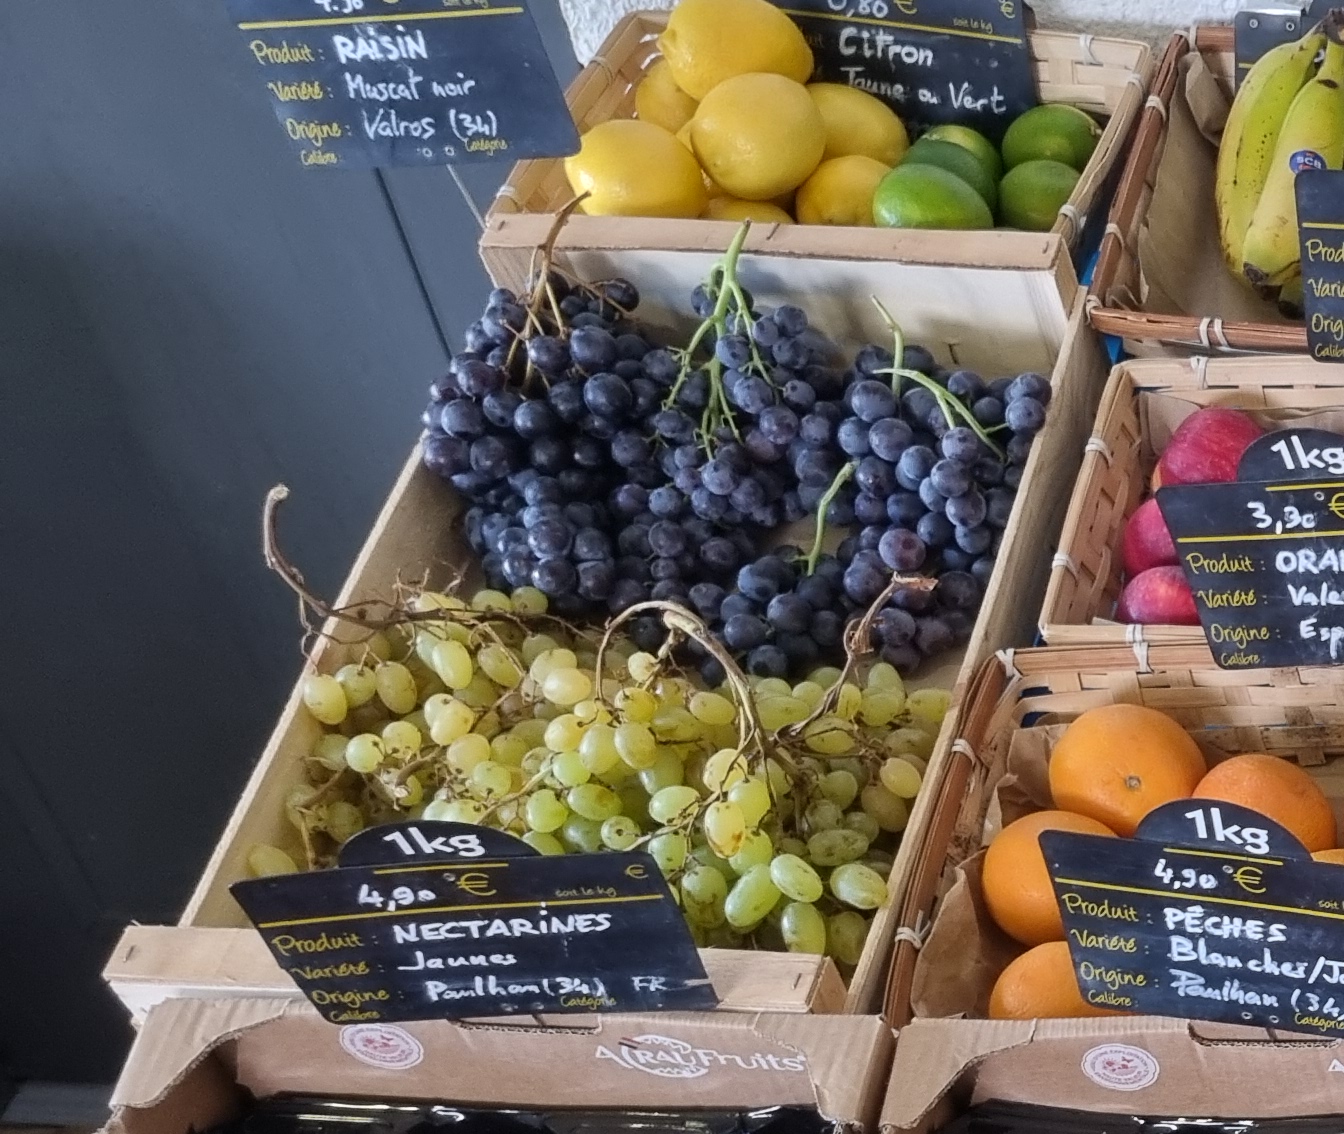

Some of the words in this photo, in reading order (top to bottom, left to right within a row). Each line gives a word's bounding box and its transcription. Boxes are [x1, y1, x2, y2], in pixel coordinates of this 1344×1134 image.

[838, 26, 934, 67] Citron
[345, 67, 422, 100] Muscat
[949, 81, 1006, 114] Vert
[1186, 553, 1255, 574] Produit
[1211, 624, 1270, 649] Origine
[383, 826, 487, 859] 1kg
[1184, 806, 1271, 856] 1kg
[1061, 893, 1139, 924] Produit
[1163, 905, 1288, 944] PÊCHES
[271, 932, 364, 958] Produit
[1079, 963, 1147, 990] Origine
[312, 986, 390, 1009] Origine
